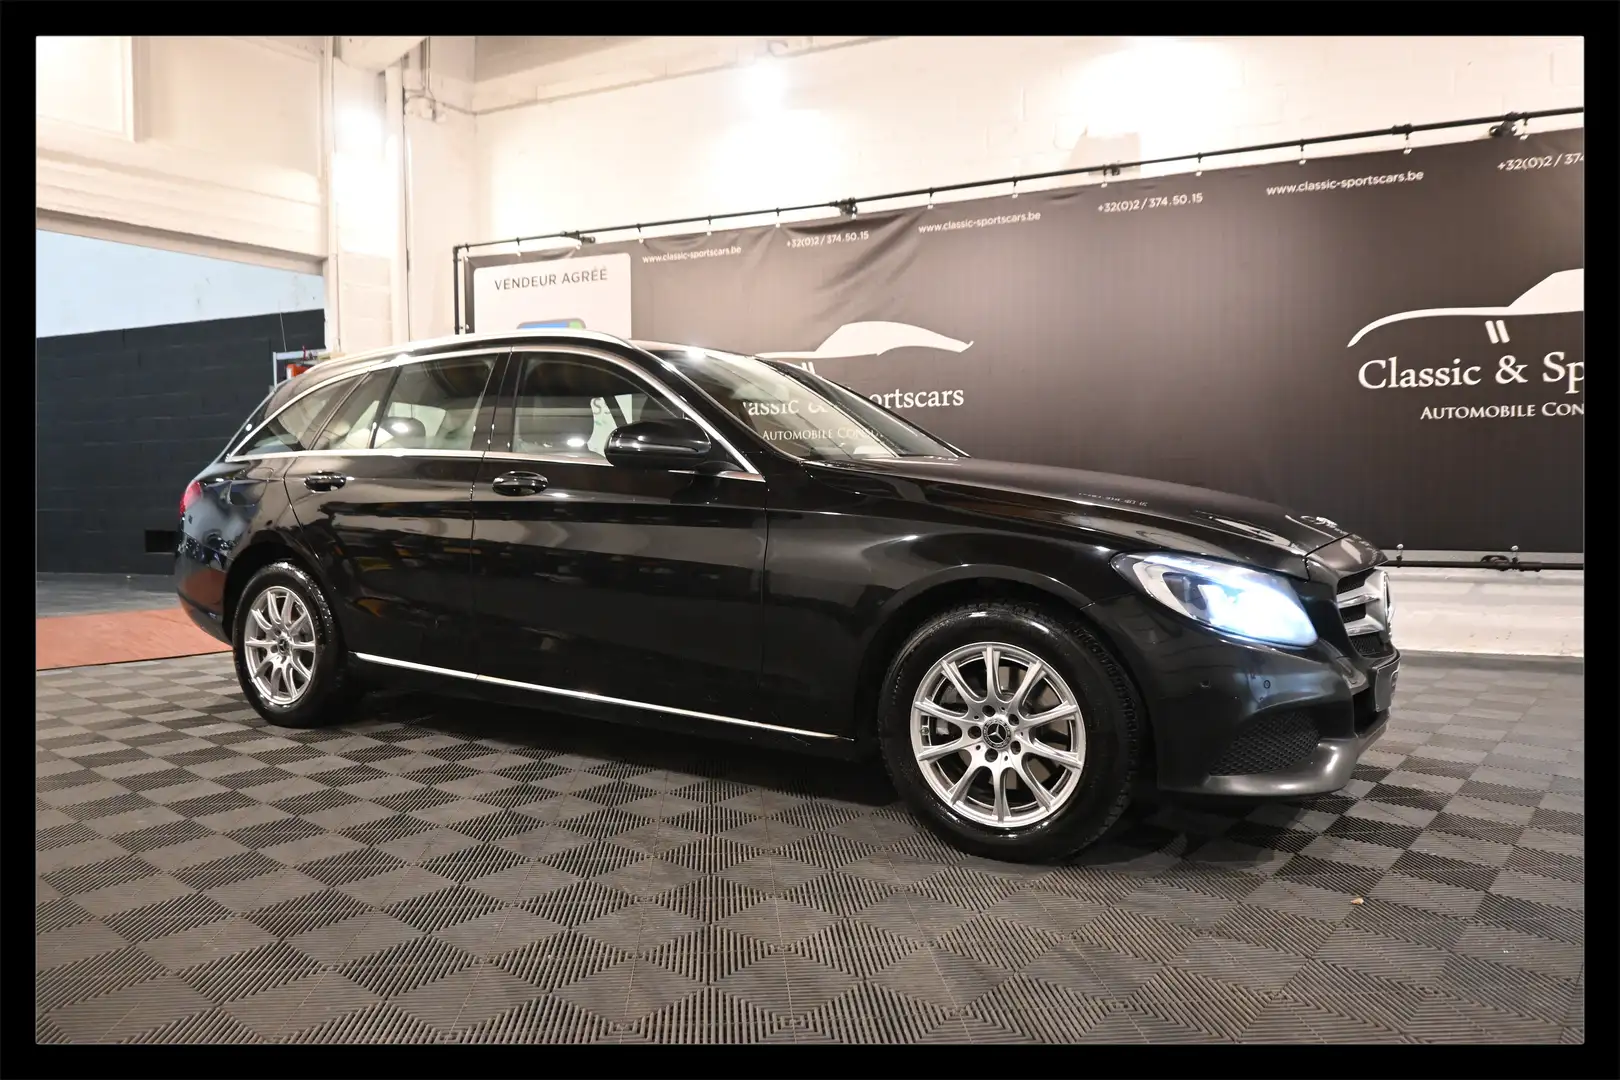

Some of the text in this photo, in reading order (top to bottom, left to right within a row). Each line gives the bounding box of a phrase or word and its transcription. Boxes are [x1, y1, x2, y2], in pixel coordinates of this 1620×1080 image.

[1266, 170, 1425, 196] www.classic-sportscars.be
[918, 211, 1042, 234] www.classic-sportscars.be
[642, 245, 742, 264] www.classic-sportscars.be
[494, 265, 609, 291] VENDEUR AGRÉÉ
[1358, 356, 1482, 390] Classic
[1495, 354, 1529, 385] &
[743, 400, 800, 416] assic
[869, 388, 965, 409] ortscars
[1420, 403, 1536, 421] AUTOMOBILE
[762, 430, 833, 441] AUTOMOBILE
